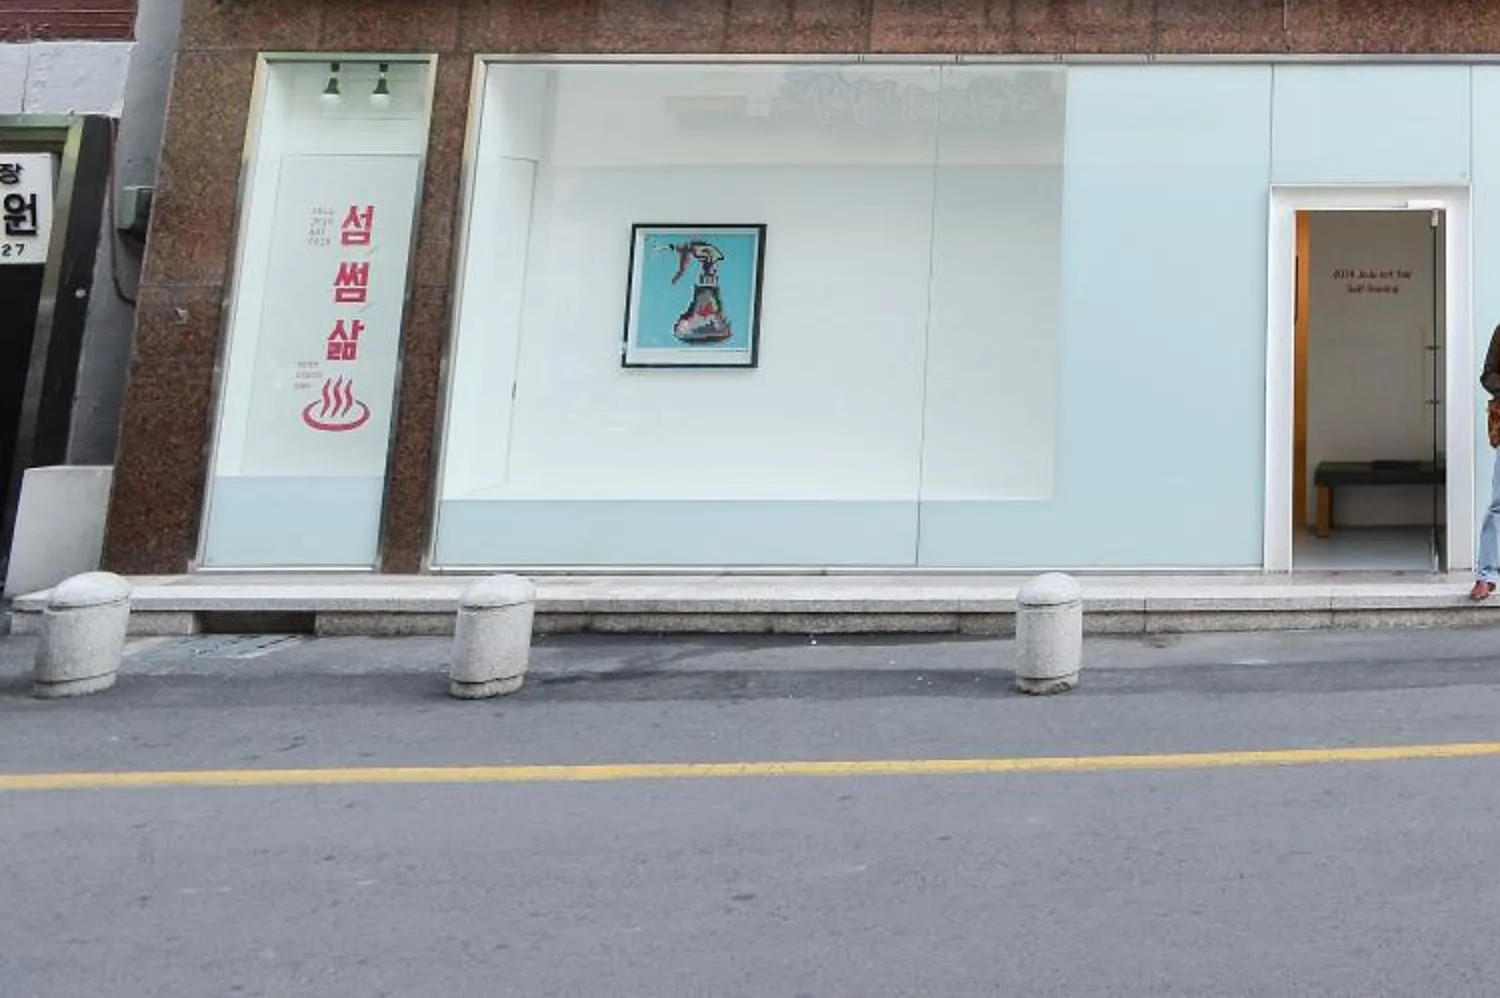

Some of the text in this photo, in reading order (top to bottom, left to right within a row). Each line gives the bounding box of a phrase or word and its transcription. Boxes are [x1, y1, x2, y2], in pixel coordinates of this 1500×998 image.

[3, 193, 38, 236] 원
[341, 204, 375, 246] 섬
[333, 261, 371, 303] 썸
